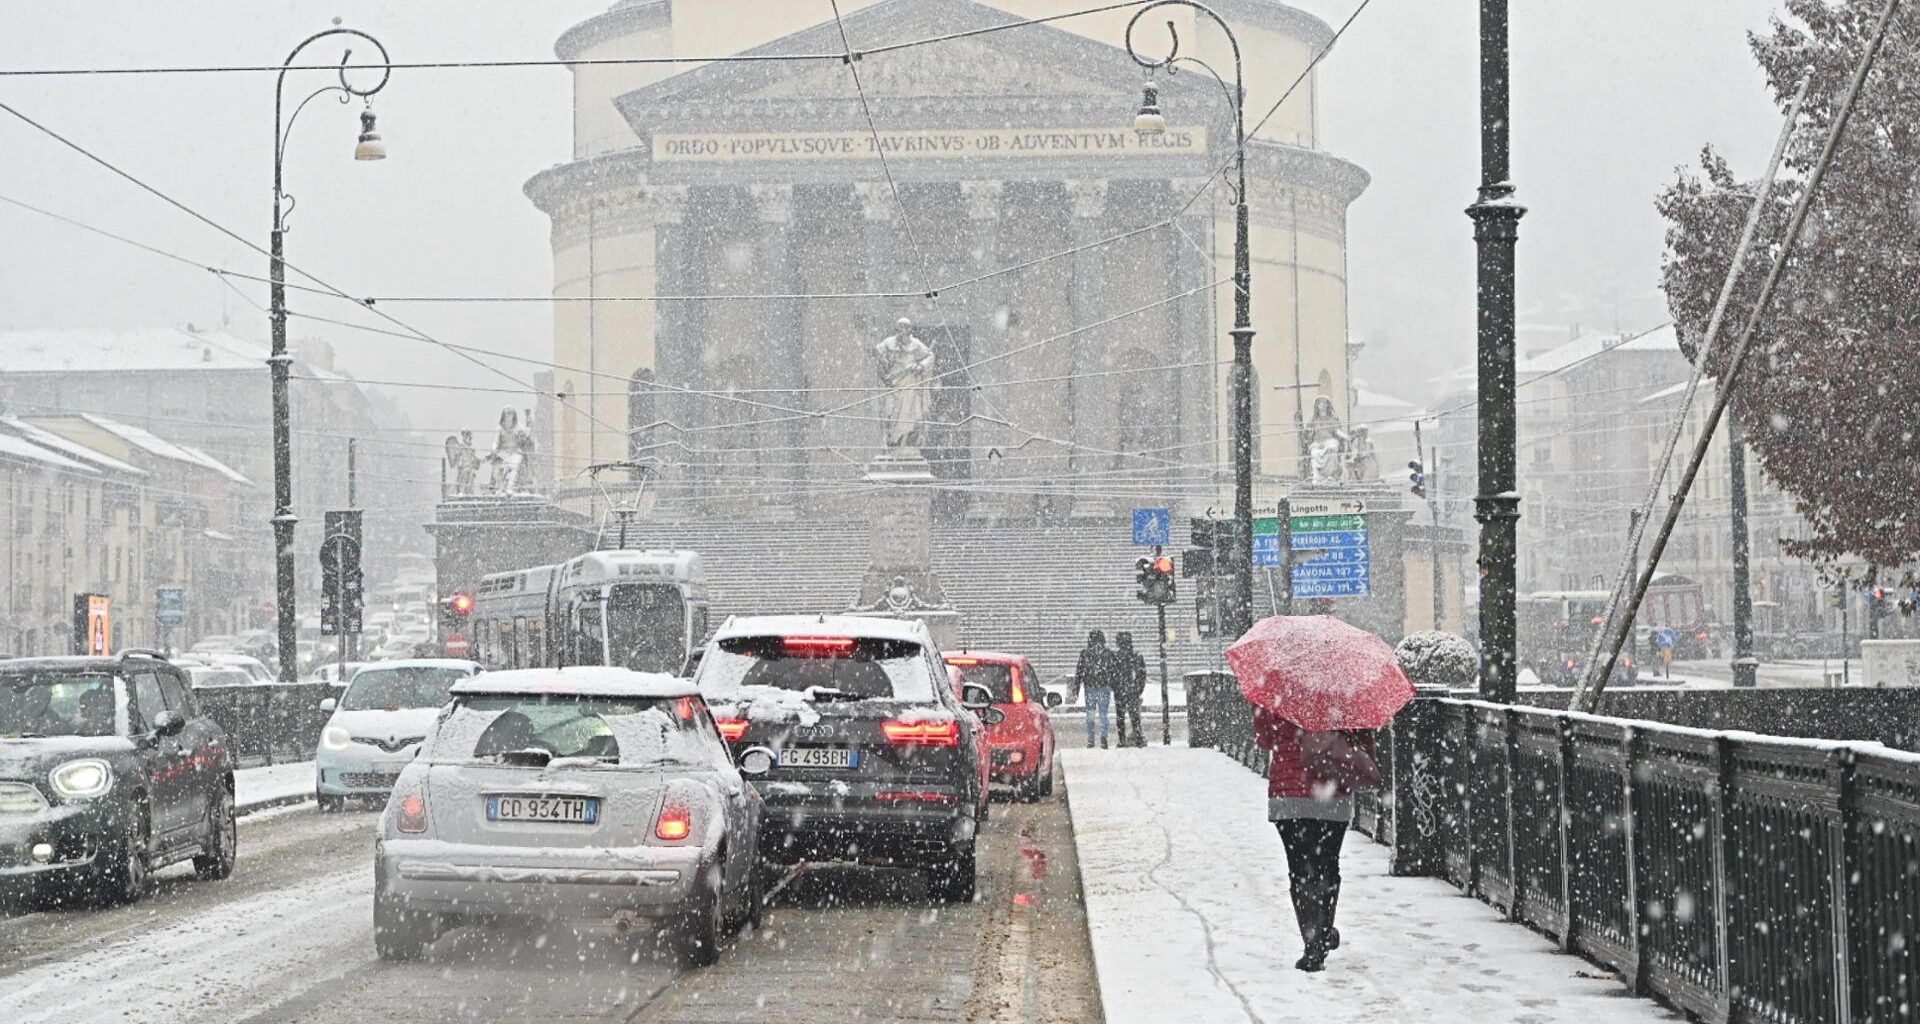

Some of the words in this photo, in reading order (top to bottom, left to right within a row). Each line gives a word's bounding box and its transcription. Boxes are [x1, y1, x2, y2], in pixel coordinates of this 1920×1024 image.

[664, 139, 719, 155] ORDO
[729, 137, 854, 155] POPVLVSQVE
[864, 135, 965, 153] TAVRINVS
[975, 135, 1000, 151] OB
[1009, 133, 1125, 151] ADVENTVM
[1136, 132, 1193, 148] REGIS
[1291, 504, 1328, 514] Lingotto
[1292, 568, 1333, 577] SAVONA
[780, 749, 798, 765] FG
[803, 749, 849, 765] 493BH
[500, 799, 522, 817] CD
[528, 799, 584, 819] 934TH
